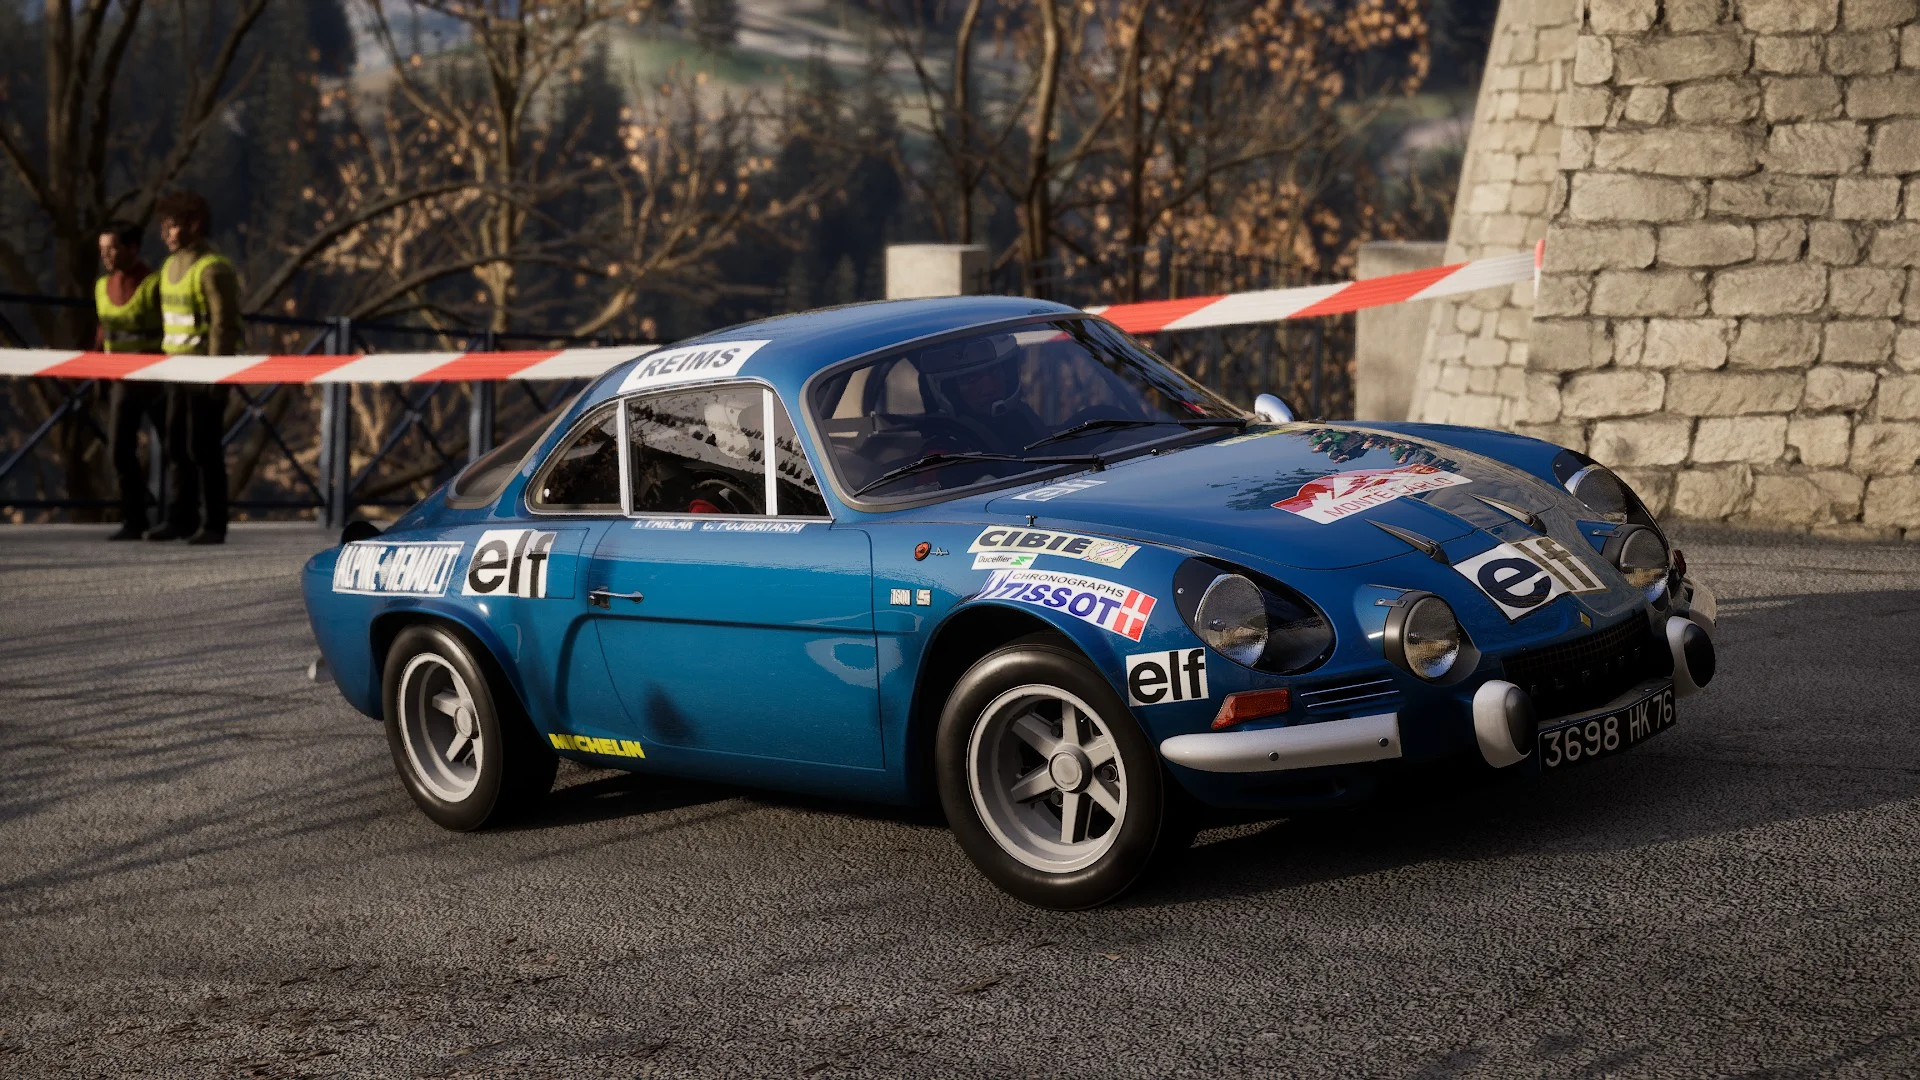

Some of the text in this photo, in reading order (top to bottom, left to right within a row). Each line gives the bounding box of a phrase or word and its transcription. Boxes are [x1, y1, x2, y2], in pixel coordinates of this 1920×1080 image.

[637, 348, 741, 379] REIMS
[1323, 490, 1394, 518] MONTE
[1390, 477, 1455, 496] CARLO
[336, 545, 460, 592] ALPINE RENAULT
[468, 530, 557, 598] elf
[1012, 572, 1125, 598] CHRONOGRAPHS
[1477, 538, 1597, 608] elf
[995, 582, 1122, 625] TISSOT
[1129, 649, 1205, 704] elf
[548, 733, 646, 759] MICHELIN
[1544, 690, 1673, 767] 3698 HK 76
